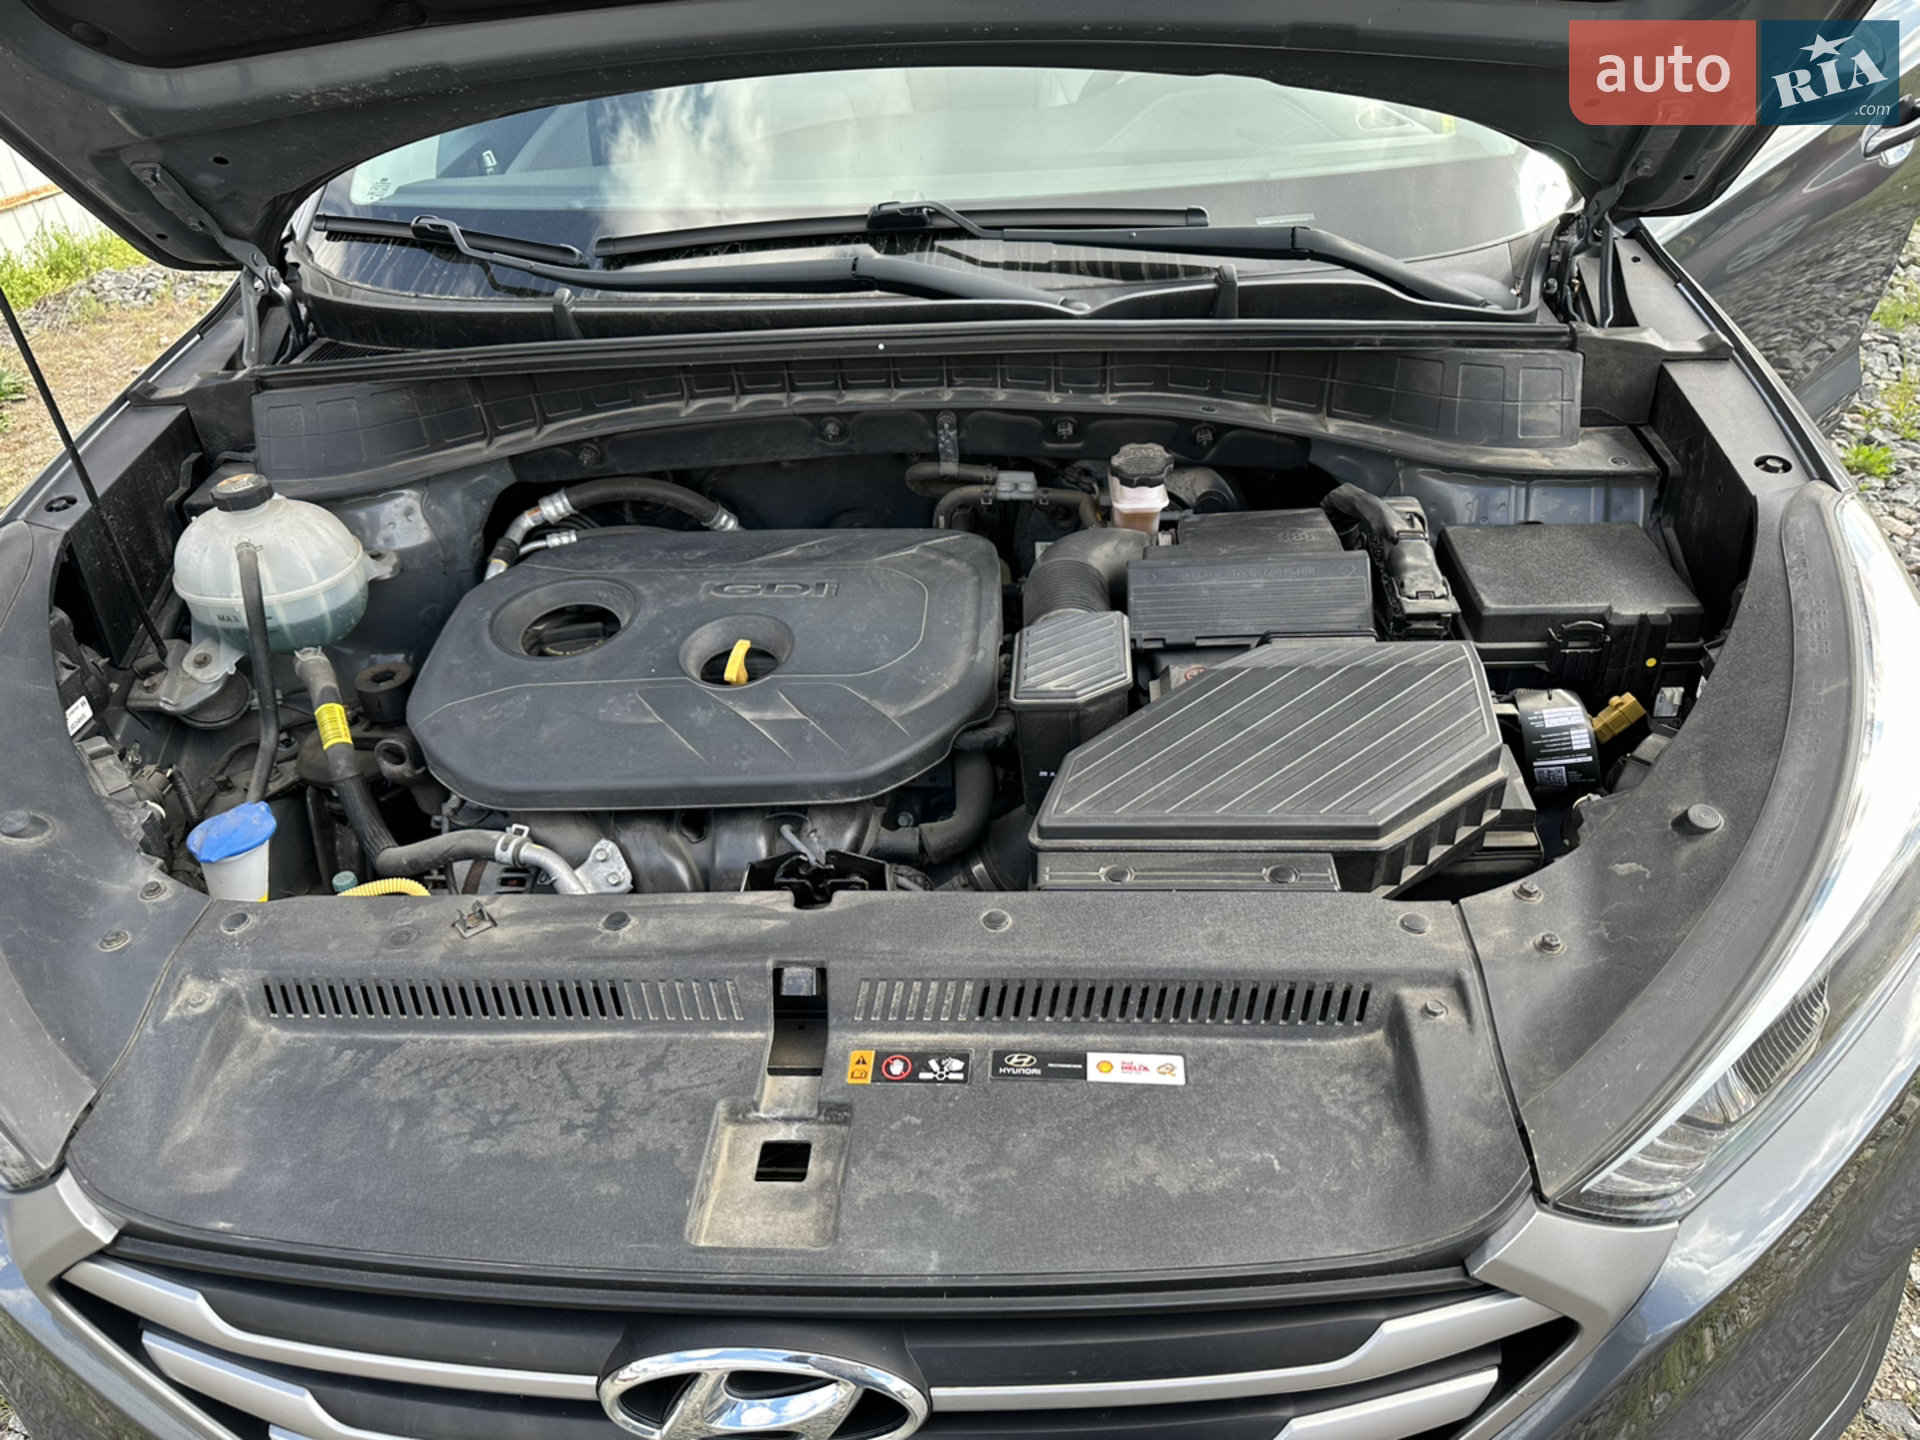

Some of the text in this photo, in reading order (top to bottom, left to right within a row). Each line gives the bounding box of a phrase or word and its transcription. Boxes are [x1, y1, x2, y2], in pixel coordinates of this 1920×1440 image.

[710, 582, 829, 598] GDI
[216, 614, 240, 623] MAX
[999, 1067, 1042, 1076] HYUNDAI
